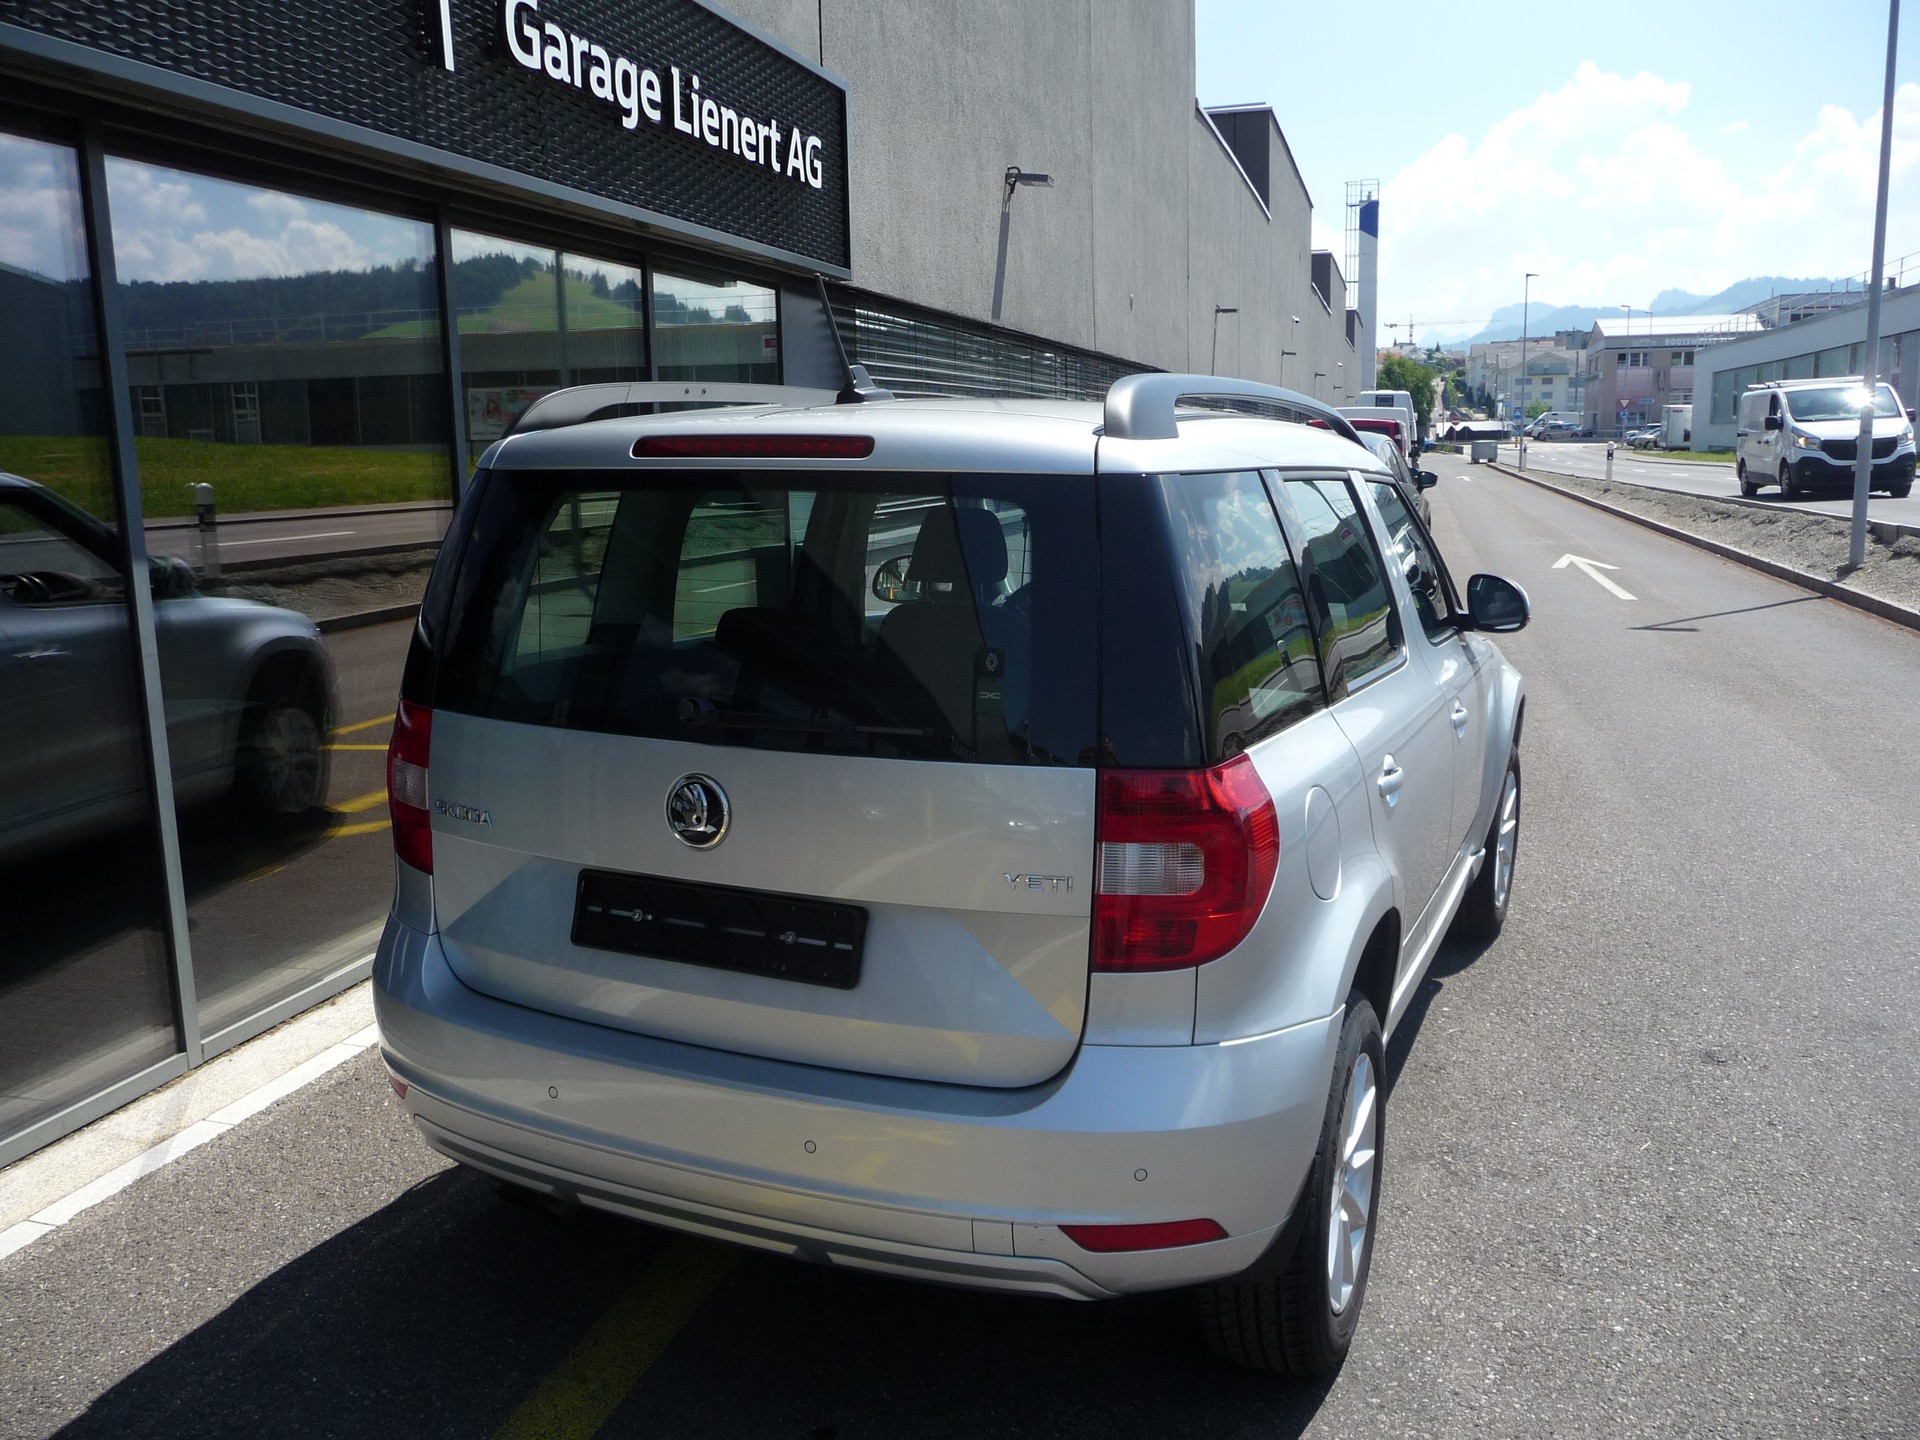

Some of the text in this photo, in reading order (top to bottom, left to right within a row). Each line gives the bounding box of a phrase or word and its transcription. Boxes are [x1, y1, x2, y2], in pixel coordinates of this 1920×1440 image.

[504, 0, 823, 189] Garage Lienert AG
[1002, 872, 1074, 894] YETI
